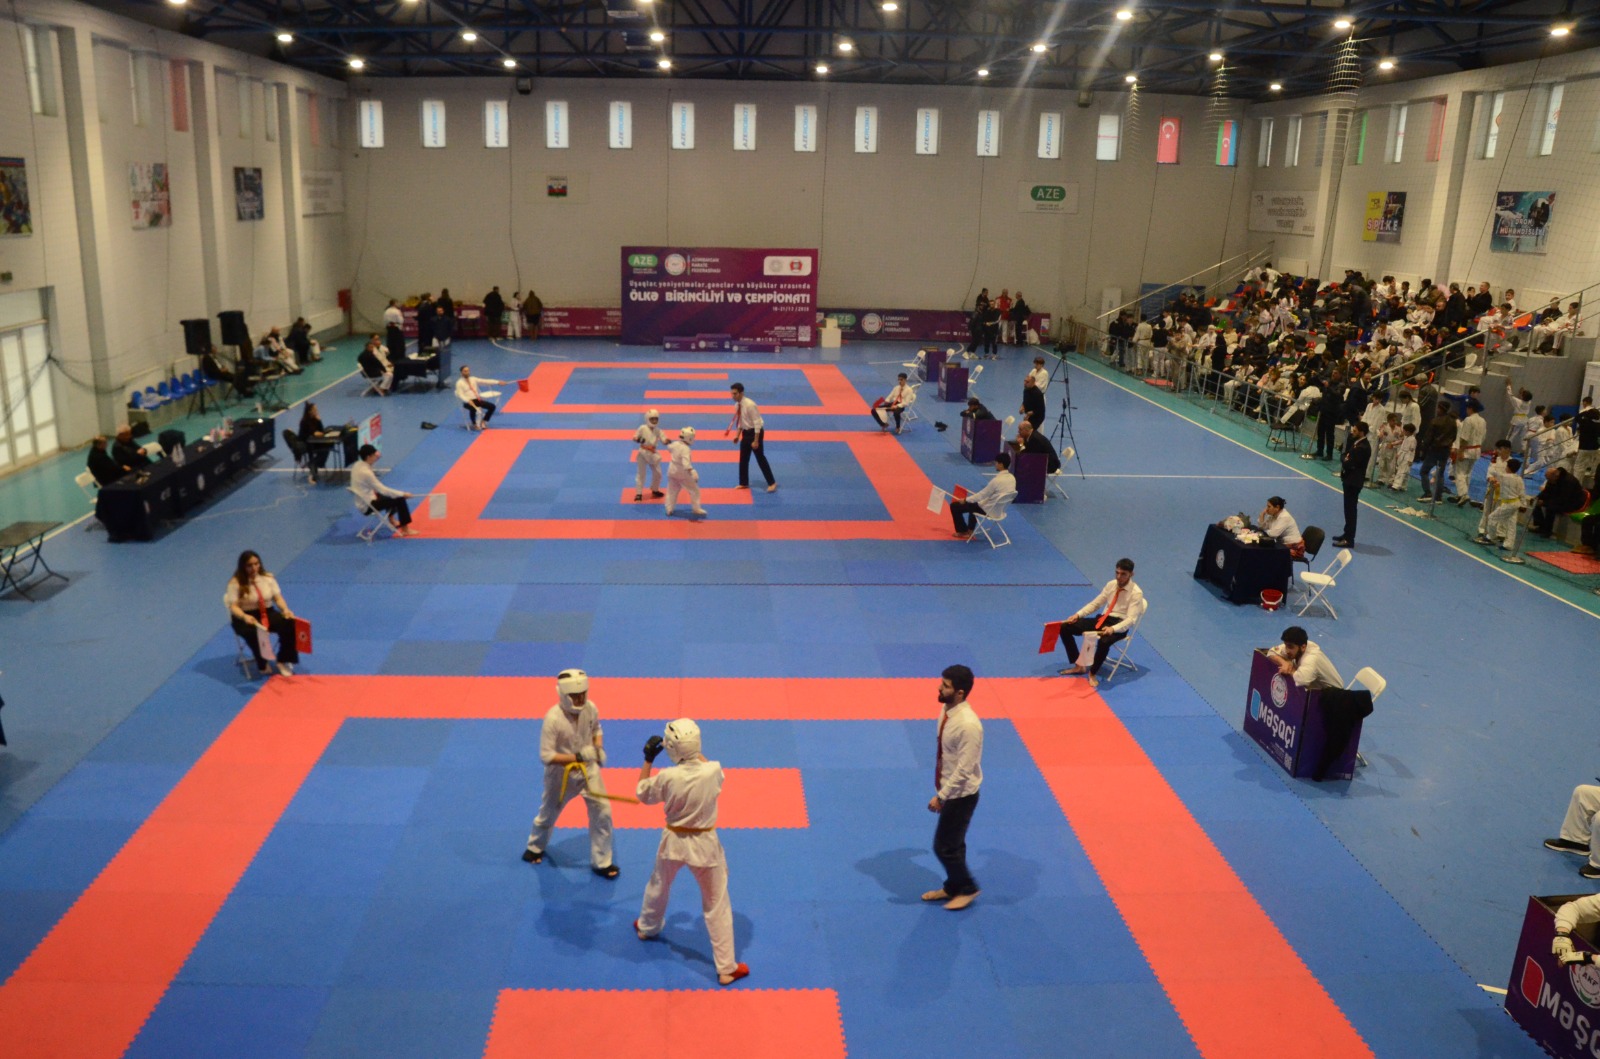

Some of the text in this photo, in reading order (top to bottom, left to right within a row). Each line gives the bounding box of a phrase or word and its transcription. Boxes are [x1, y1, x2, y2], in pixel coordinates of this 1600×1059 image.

[1036, 188, 1061, 199] AZE
[633, 256, 653, 266] AZE
[629, 289, 811, 304] ÖLKƏ BİRİNCİLİYİ VƏ ÇEMPİONATI
[1582, 972, 1598, 986] AKF
